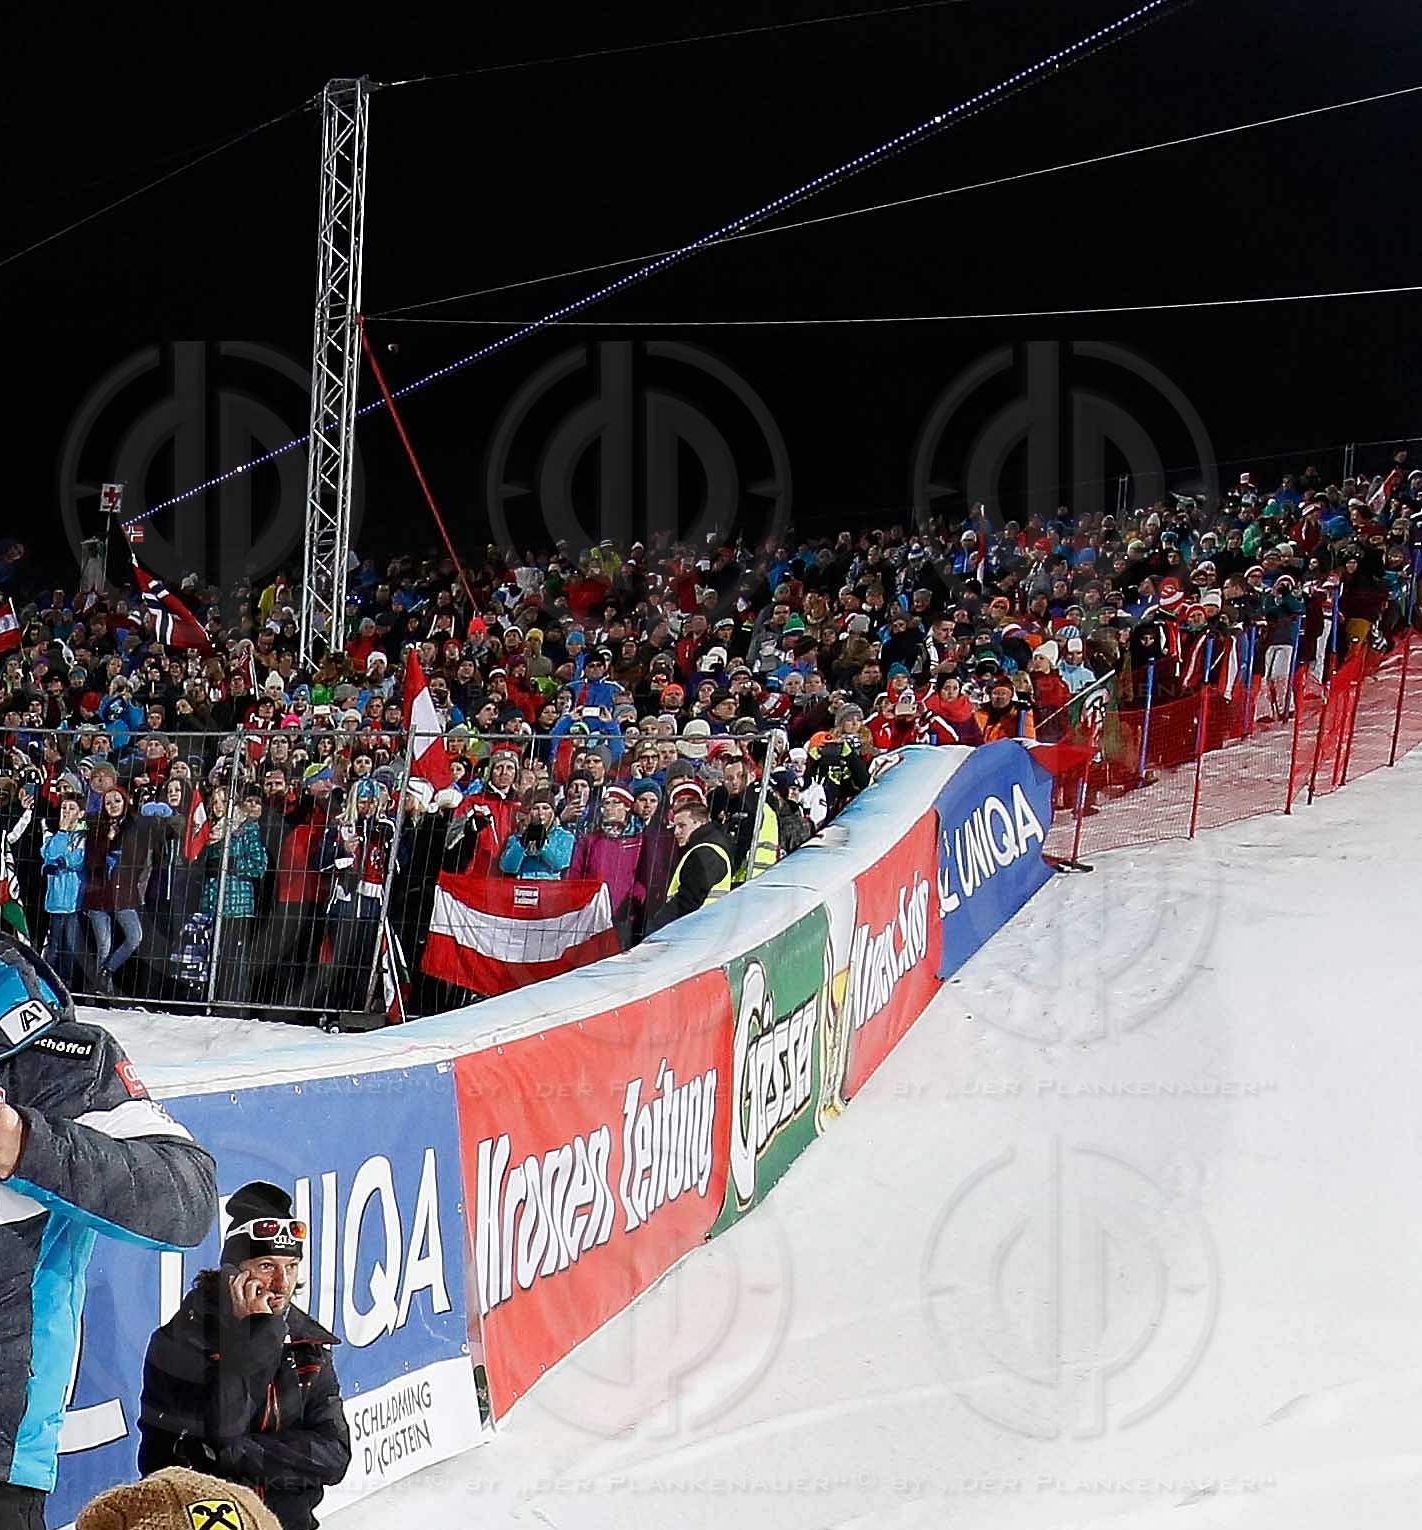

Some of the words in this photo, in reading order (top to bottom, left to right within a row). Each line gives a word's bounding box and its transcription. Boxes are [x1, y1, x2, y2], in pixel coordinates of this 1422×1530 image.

[955, 783, 1045, 897] UNIQA
[18, 1003, 42, 1032] A1
[474, 1125, 616, 1314] Kronen
[619, 1058, 718, 1232] Zeitung
[354, 1381, 432, 1441] SCHLADMING
[364, 1418, 433, 1478] DACHSTEIN
